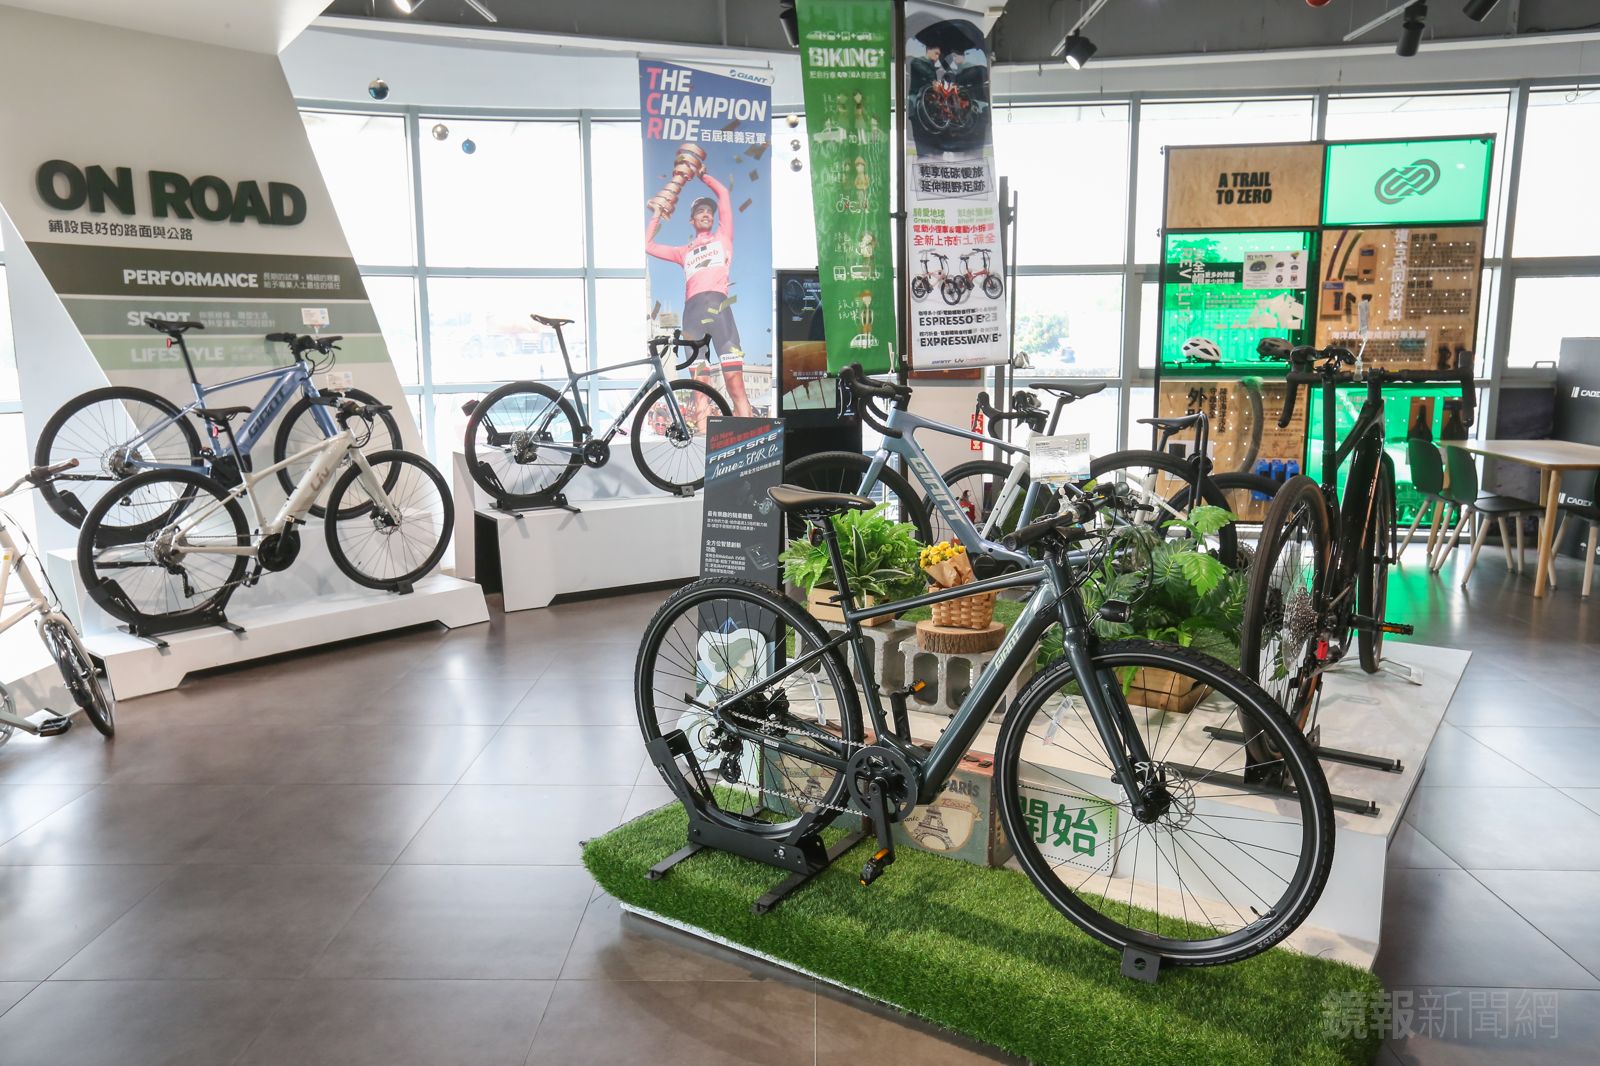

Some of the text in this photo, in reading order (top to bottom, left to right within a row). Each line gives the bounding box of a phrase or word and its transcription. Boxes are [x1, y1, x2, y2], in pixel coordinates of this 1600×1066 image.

[646, 67, 692, 92] THE
[737, 72, 767, 84] GIANT
[646, 92, 767, 122] CHAMPION
[647, 117, 700, 142] RIDE
[1218, 171, 1271, 188] A TRAIL
[36, 159, 307, 225] ON ROAD
[1216, 188, 1272, 205] TO ZERO
[48, 219, 193, 240] 鋪設良好的路面與公路
[687, 250, 719, 268] Sunweb
[123, 269, 258, 288] PERFORMANCE
[127, 311, 191, 326] SPORT
[919, 315, 973, 326] ESPRESSO
[920, 335, 989, 347] EXPRESSWAY
[310, 466, 330, 492] Liv
[1020, 796, 1098, 857] 開始
